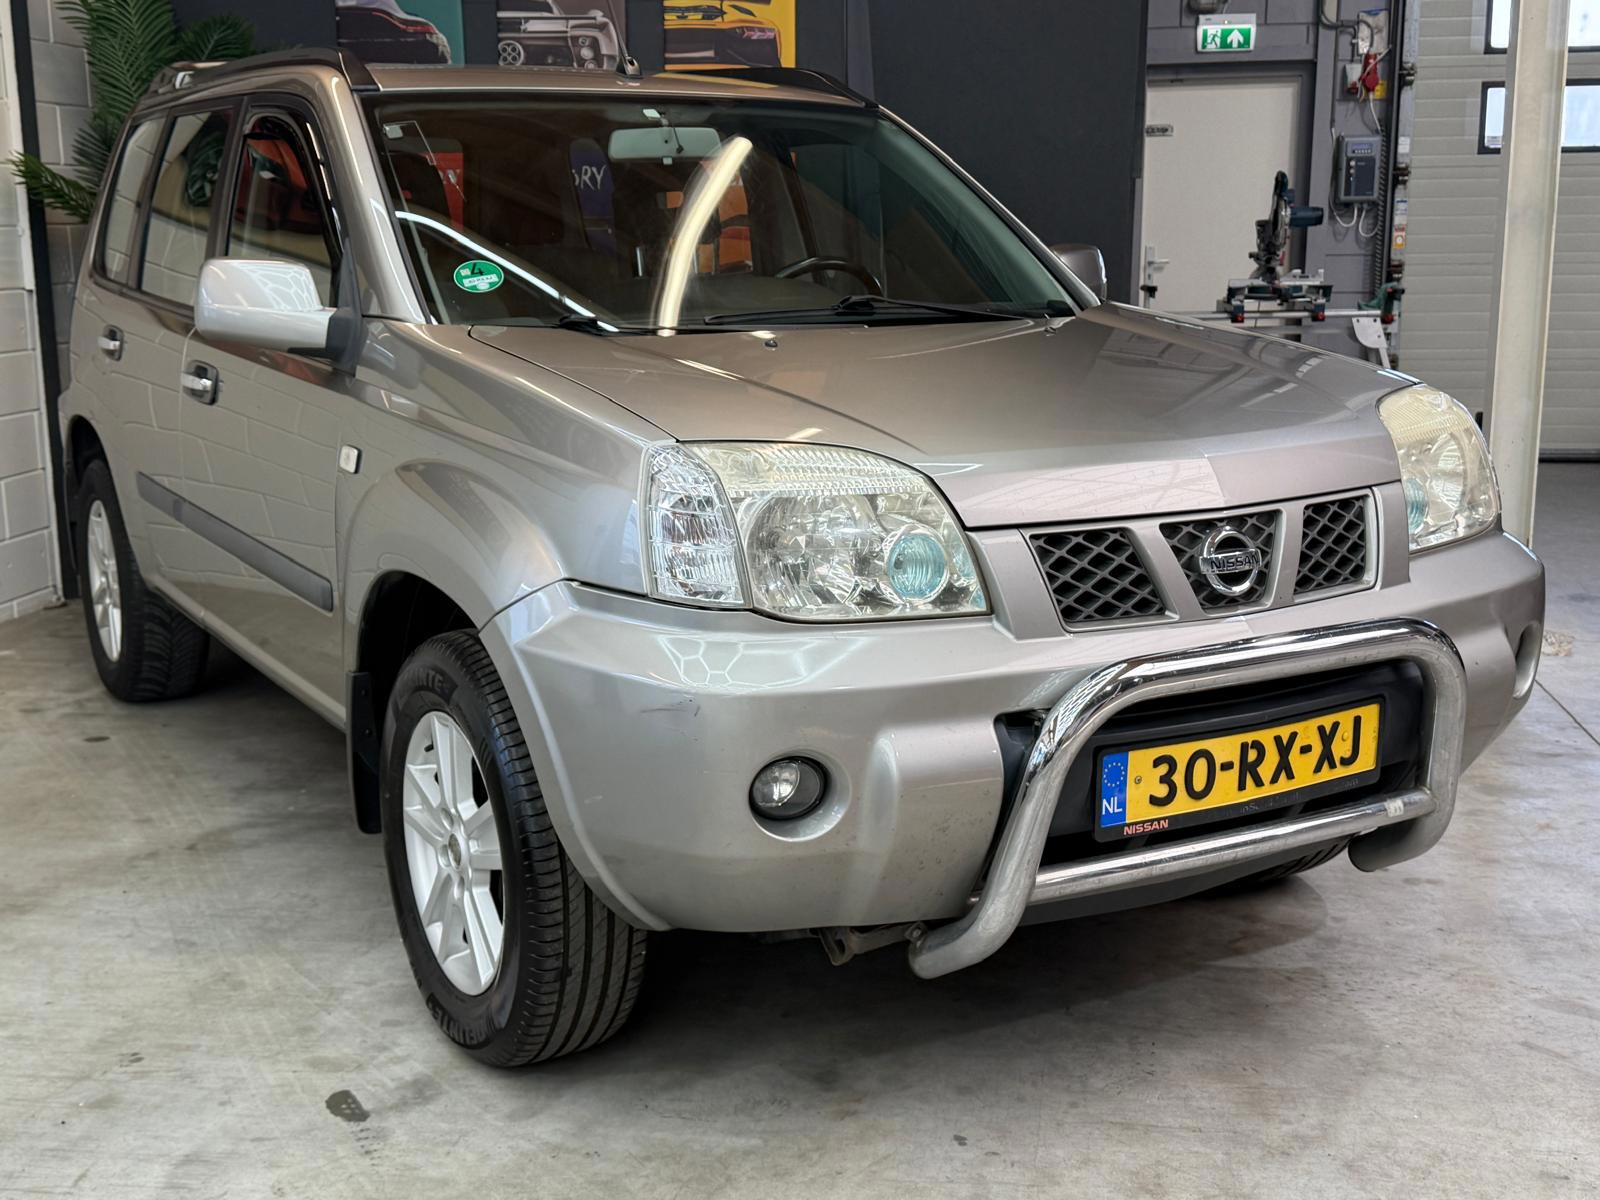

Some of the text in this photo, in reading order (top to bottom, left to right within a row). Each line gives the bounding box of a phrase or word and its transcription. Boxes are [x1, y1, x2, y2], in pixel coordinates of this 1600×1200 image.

[1210, 554, 1259, 571] NISSAN
[1149, 715, 1362, 807] 30-RX-XJ
[1102, 796, 1123, 815] NL
[1123, 819, 1169, 836] NISSAN
